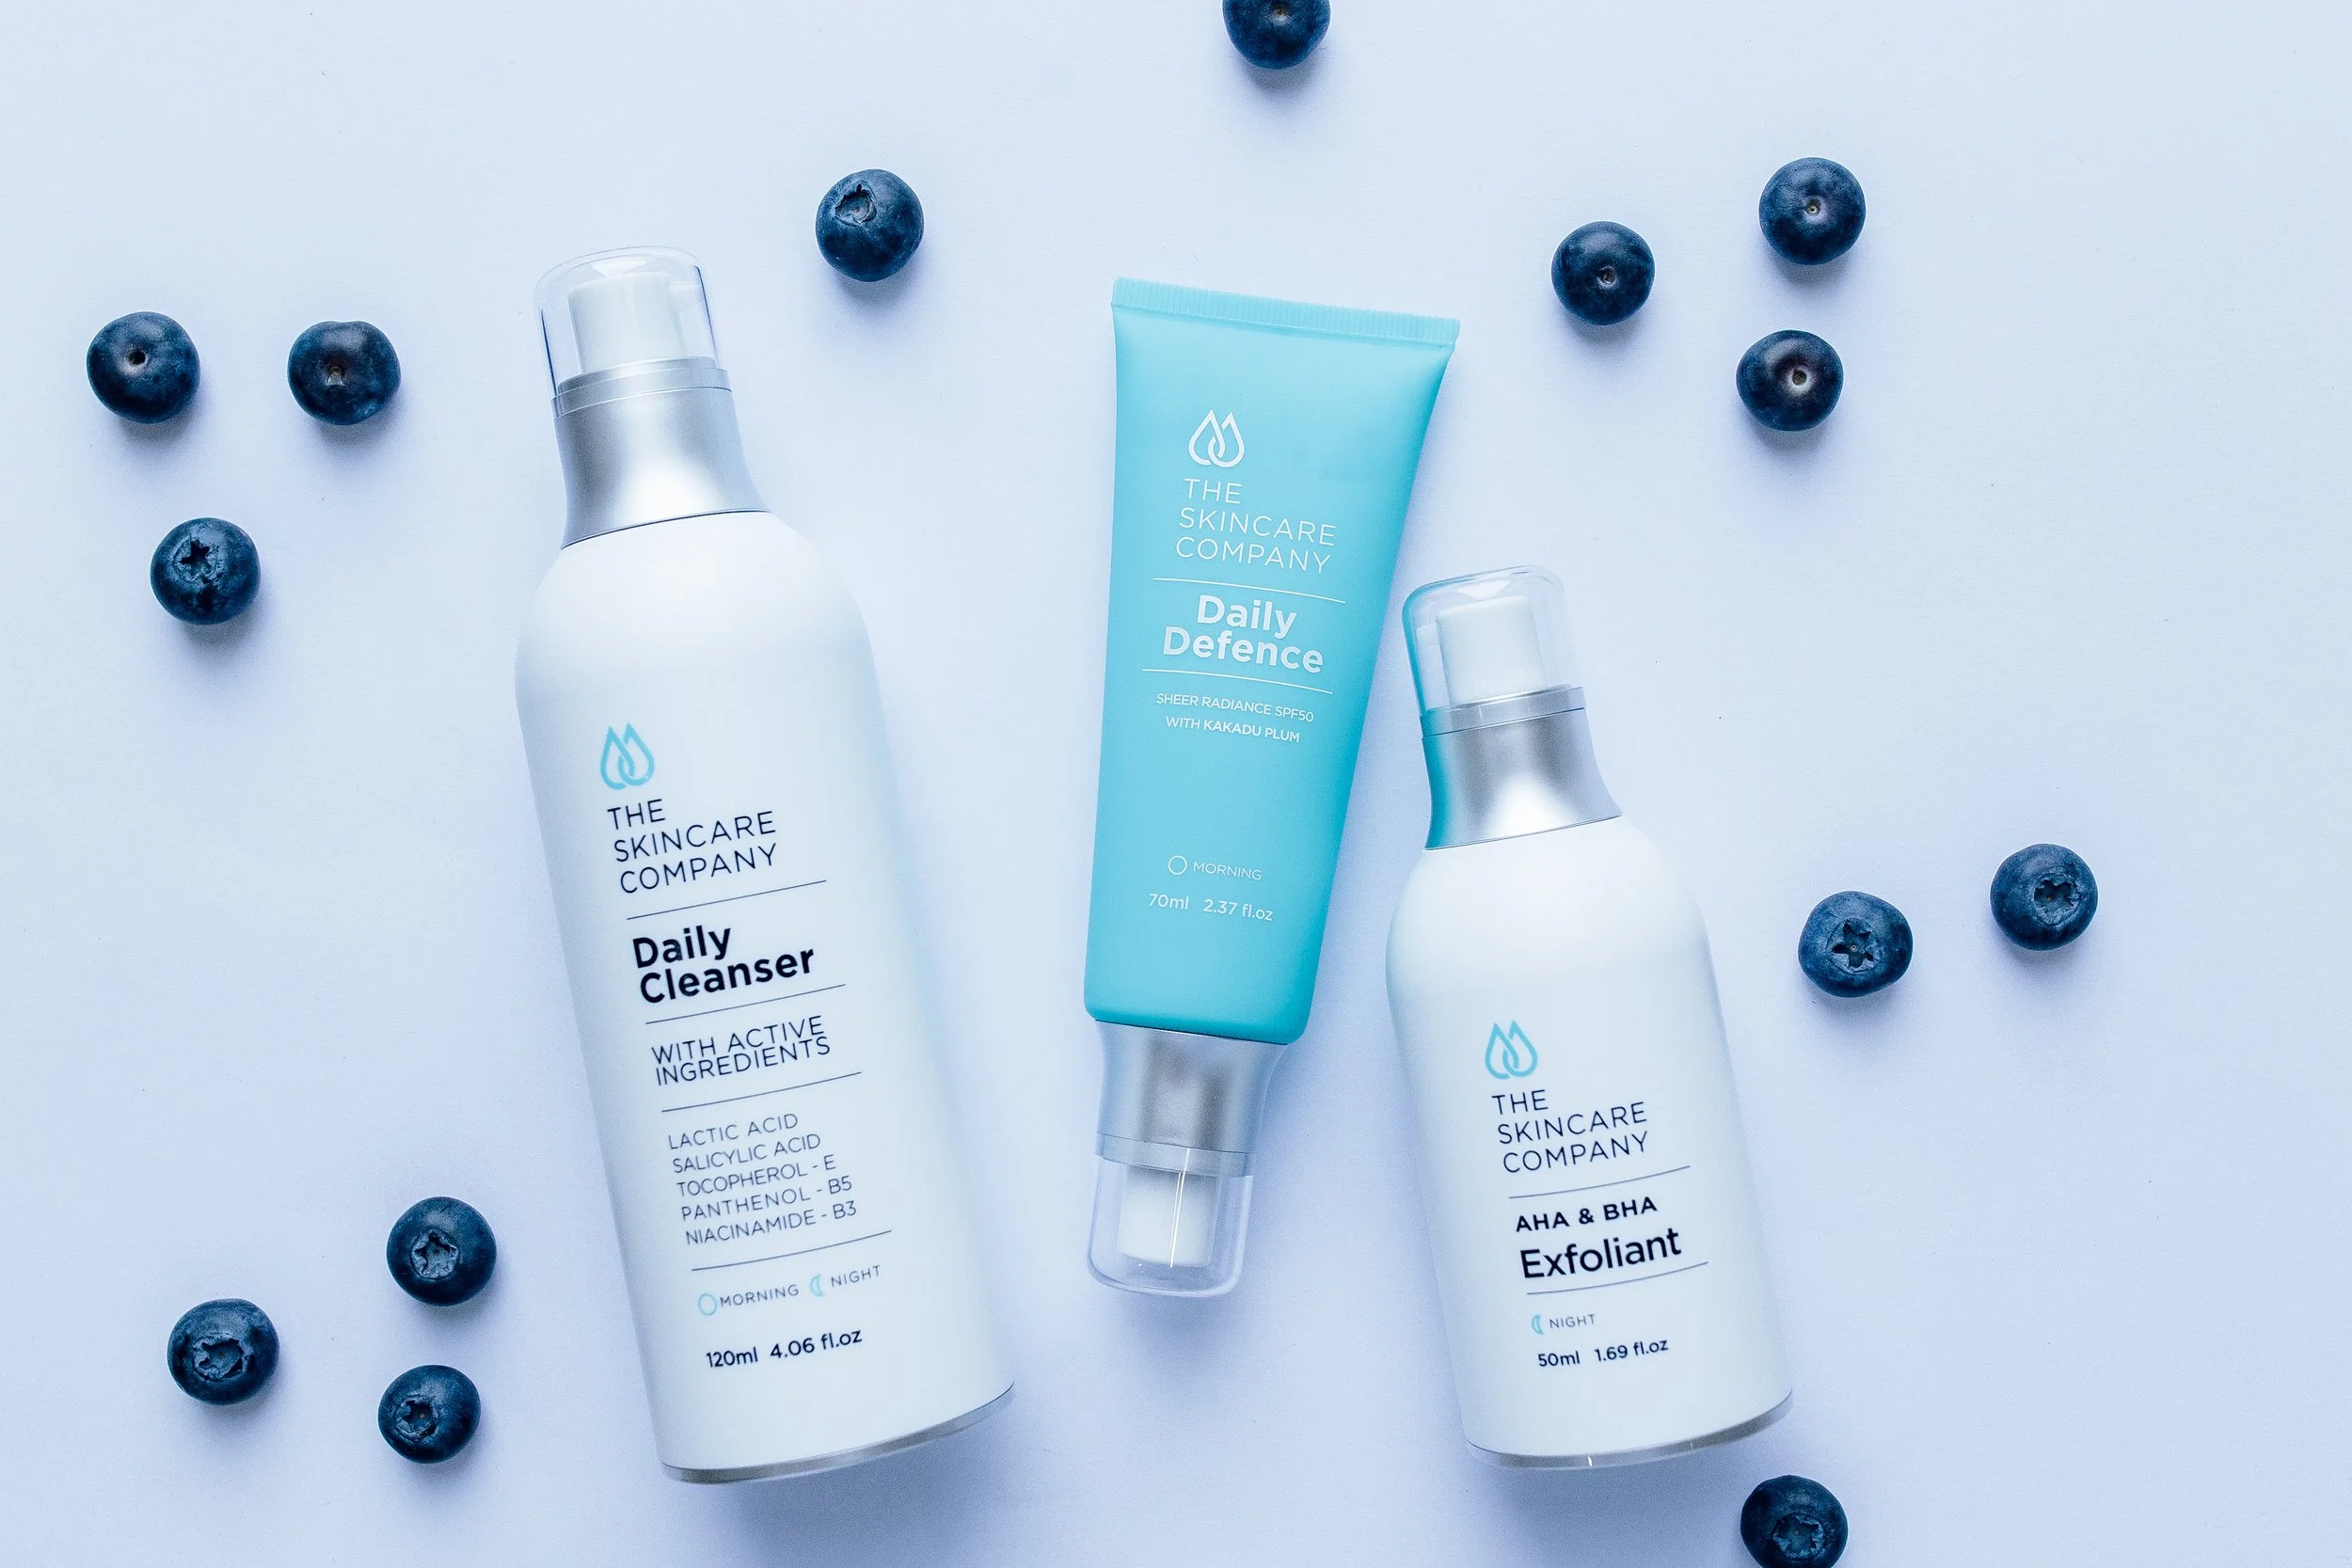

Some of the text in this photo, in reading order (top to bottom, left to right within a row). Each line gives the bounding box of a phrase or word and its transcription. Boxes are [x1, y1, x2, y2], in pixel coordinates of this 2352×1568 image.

[1184, 478, 1242, 504] THE
[1179, 507, 1336, 546] SKINCARE
[1176, 536, 1331, 574] COMPANY
[1197, 594, 1297, 640] Daily
[1163, 626, 1324, 673] Defence
[1156, 693, 1314, 722] SHEER RADIANCE SPF50
[1167, 717, 1299, 743] WITH KAKADU PLUM
[607, 799, 666, 830] THE
[613, 811, 776, 862] SKINCARE
[620, 843, 777, 893] COMPANY
[1193, 862, 1262, 880] MORNING
[1149, 894, 1273, 921] 70ml 2.37 fl.oz
[632, 925, 731, 968] Daily
[640, 949, 814, 1003] Cleanser
[651, 1016, 825, 1065] WITH ACTIVE
[656, 1037, 830, 1085] INGREDIENTS
[1491, 1089, 1549, 1115] THE
[1498, 1101, 1647, 1144] SKINCARE
[669, 1114, 798, 1149] LACTIC ACID
[1503, 1131, 1647, 1173] COMPANY
[673, 1133, 820, 1173] SALICYLIC ACID
[677, 1163, 808, 1196] TOCOPHEROL
[824, 1154, 836, 1170] E
[681, 1187, 811, 1221] PANTHENOL
[828, 1176, 851, 1195] B5
[1516, 1196, 1657, 1232] AHA & BHA
[686, 1209, 817, 1244] NIACINAMIDE
[833, 1200, 857, 1220] B3
[1520, 1227, 1681, 1278] Exfoliant
[720, 1265, 881, 1307] MORNING NIGHT
[1549, 1314, 1596, 1329] NIGHT
[707, 1330, 863, 1368] 120ml 4.06 fl.oz
[1537, 1339, 1669, 1367] 50ml 1.69 fl.oz
